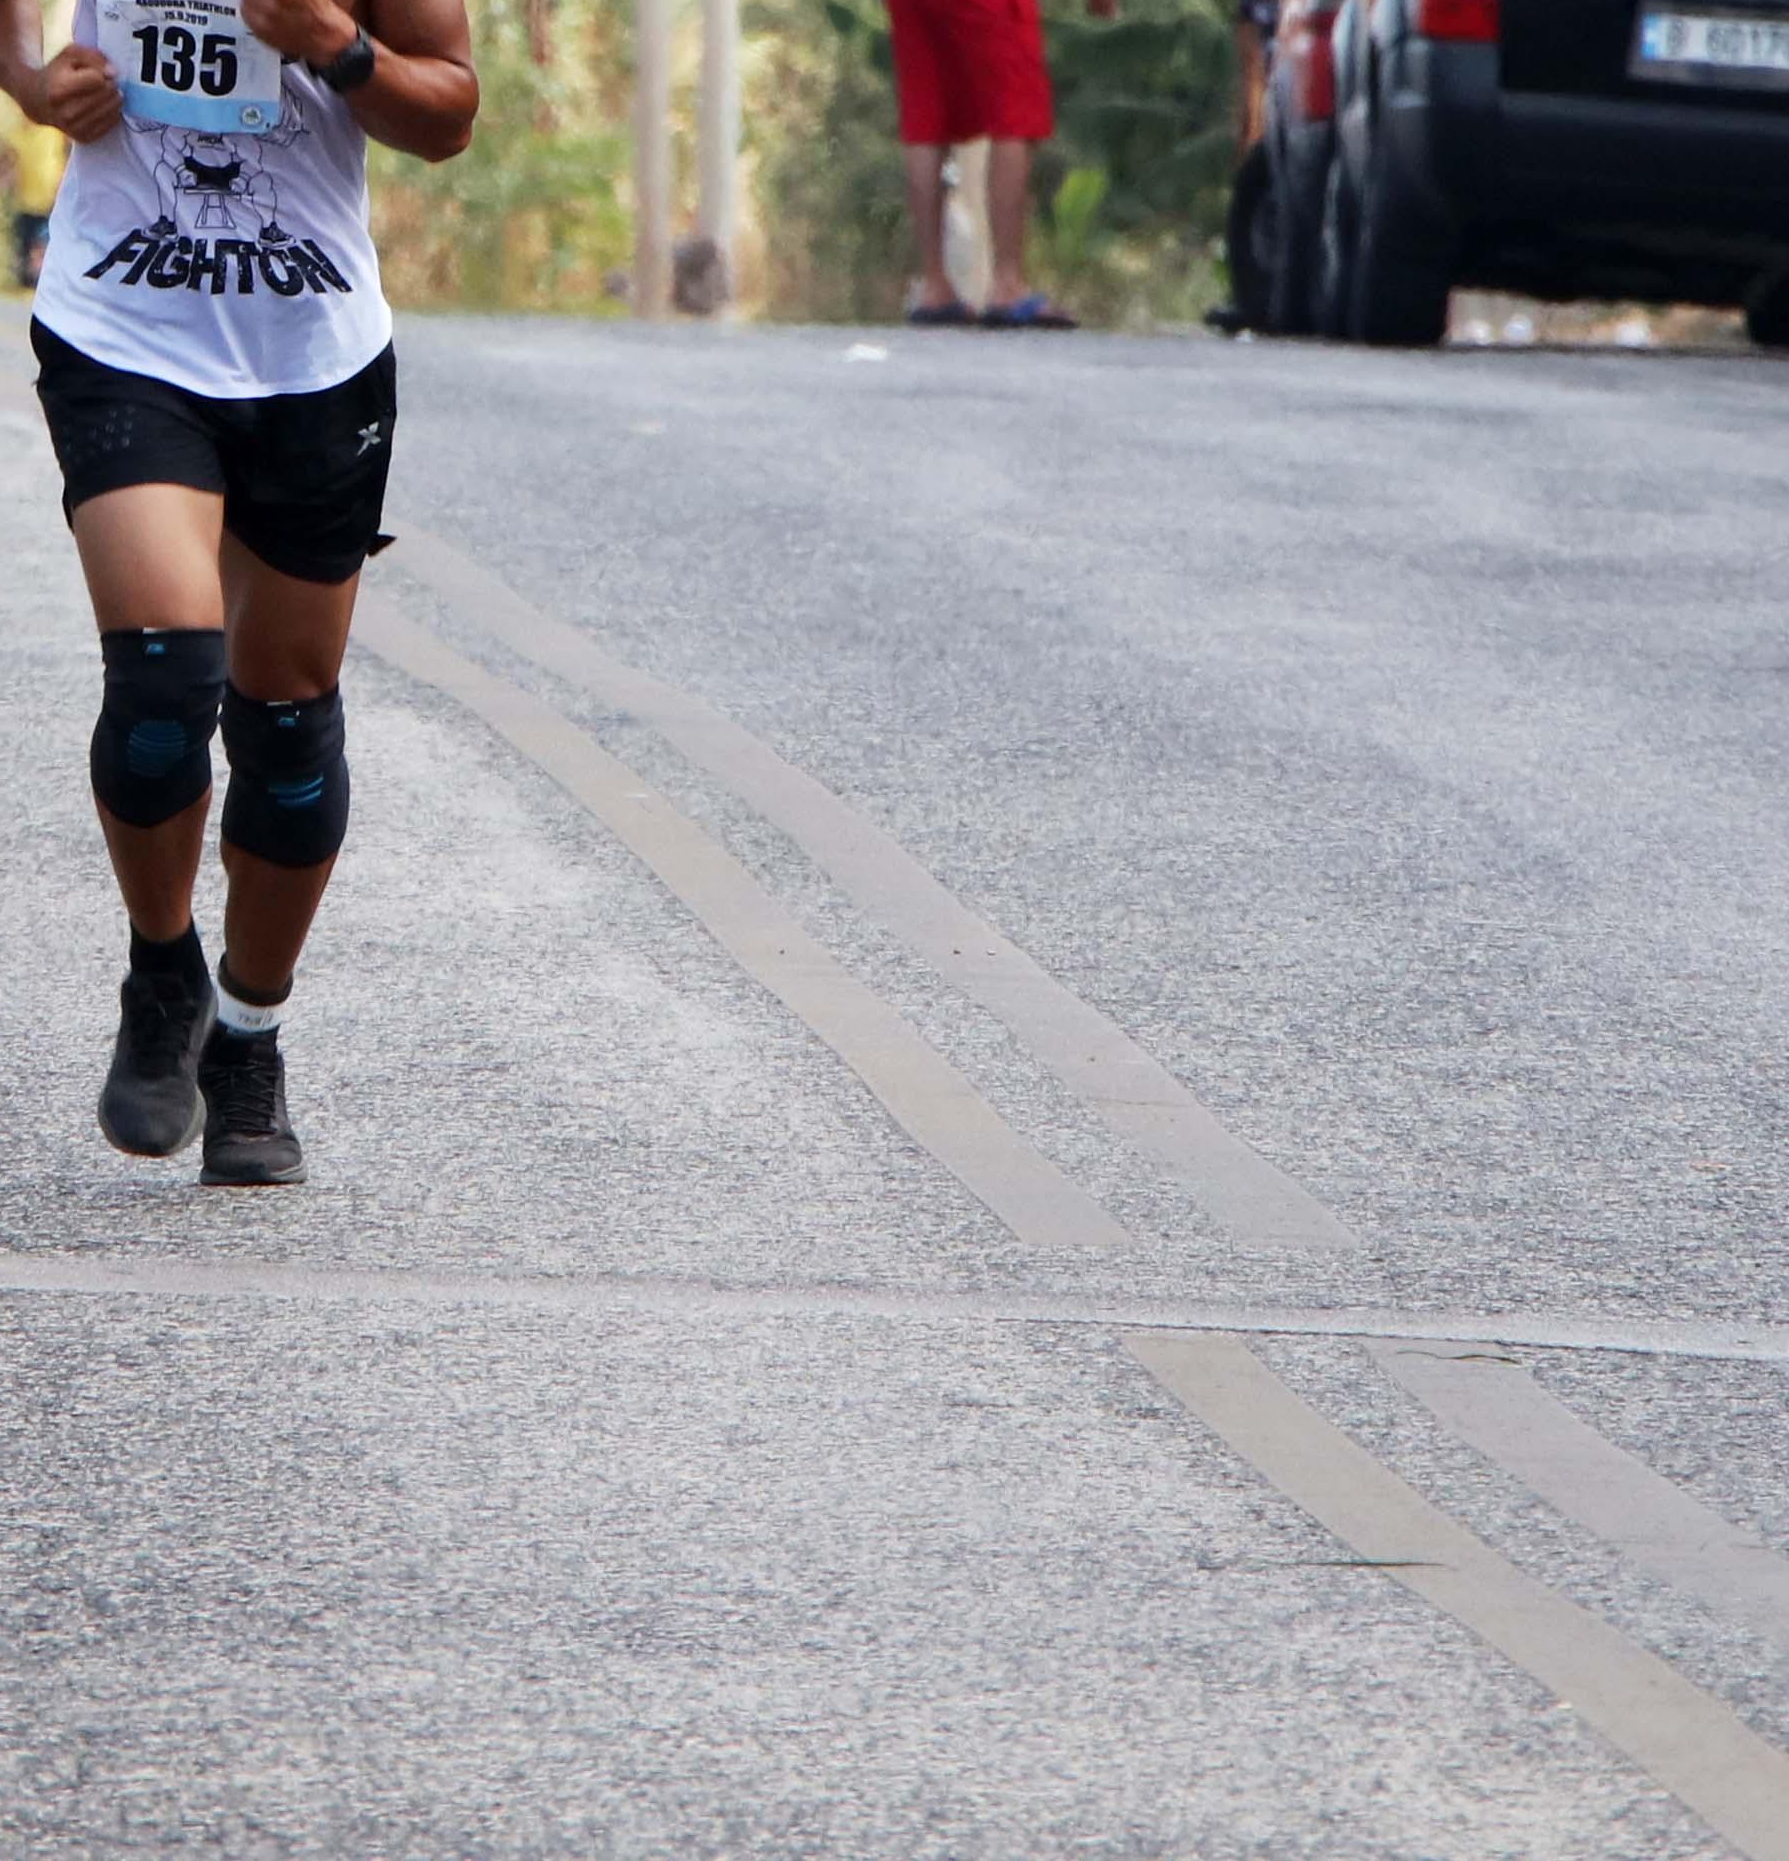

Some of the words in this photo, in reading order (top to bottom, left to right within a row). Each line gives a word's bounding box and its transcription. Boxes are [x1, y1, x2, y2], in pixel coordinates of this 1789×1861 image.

[188, 0, 237, 17] TRIATHLON
[164, 10, 209, 26] 15.9.2019
[132, 25, 238, 97] 135
